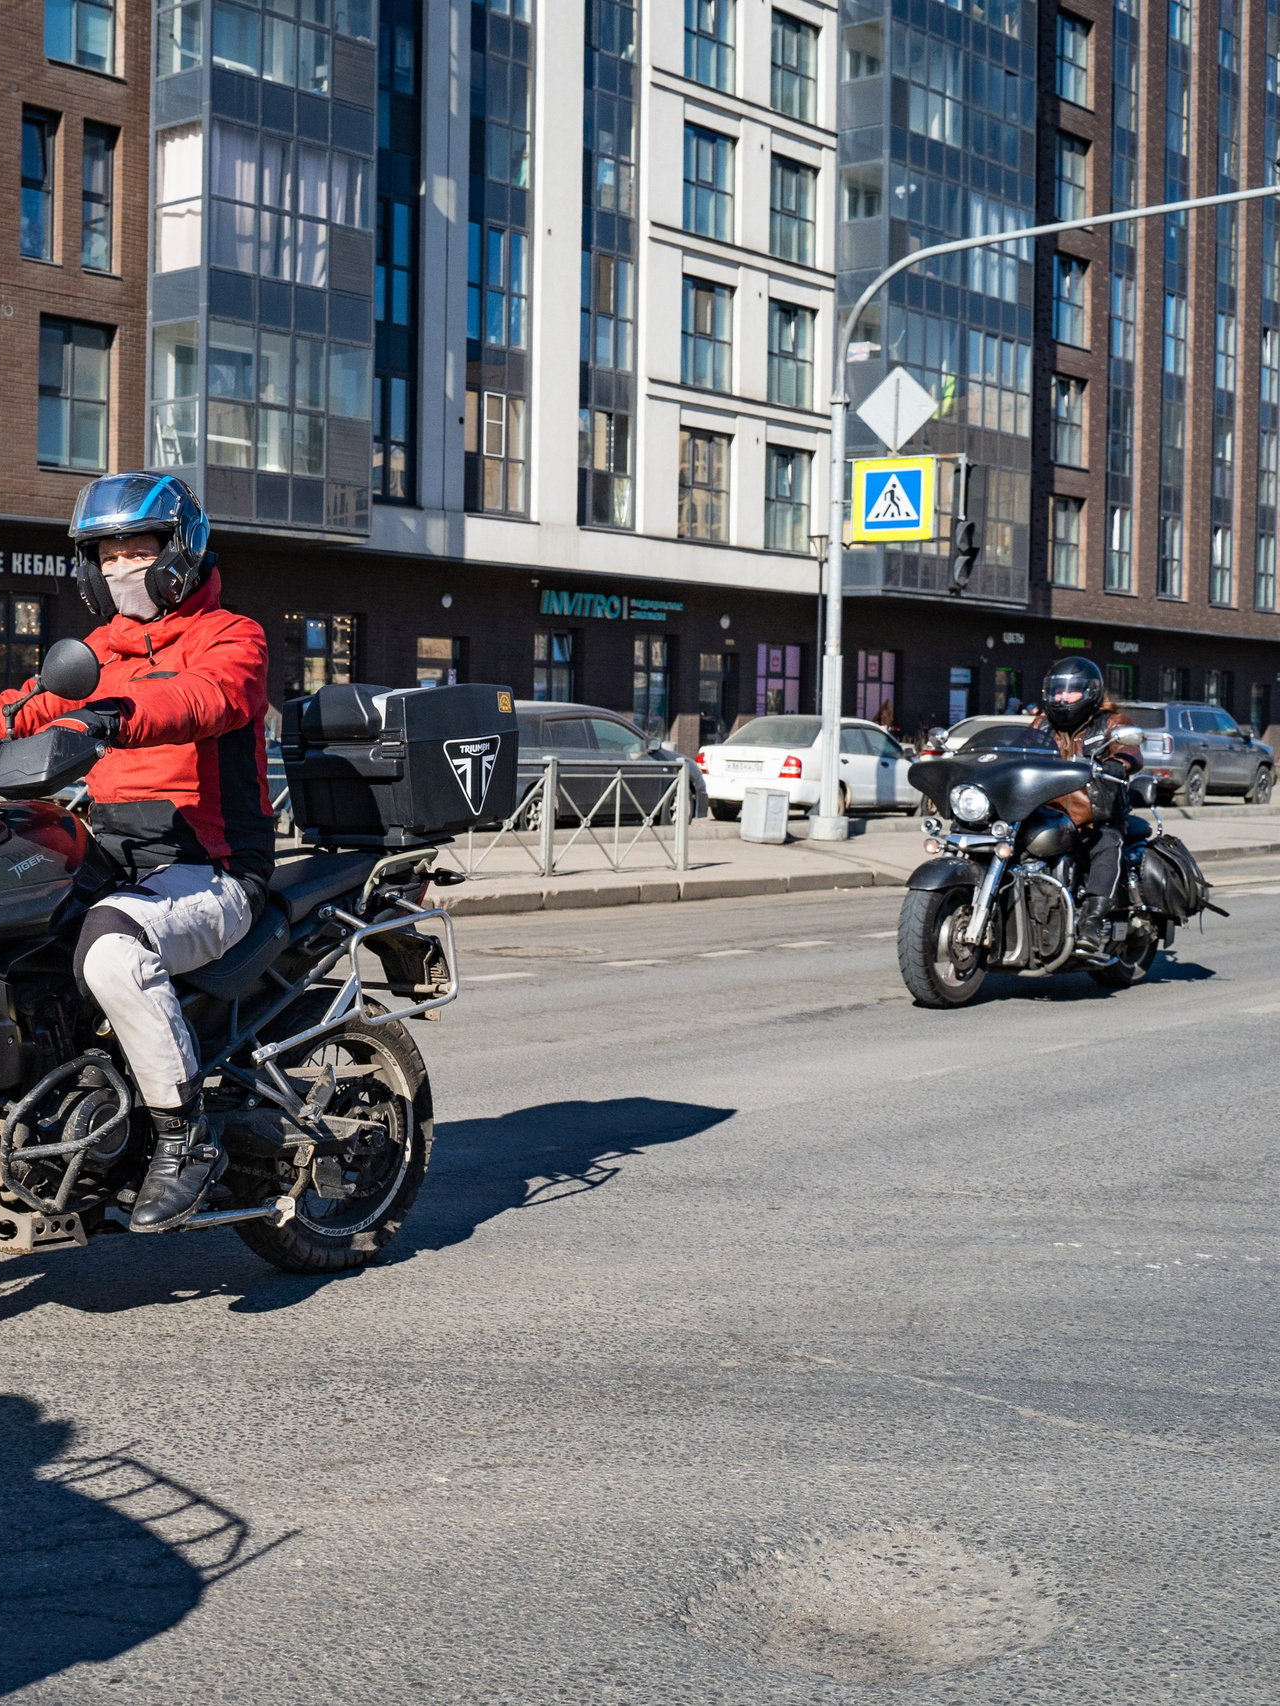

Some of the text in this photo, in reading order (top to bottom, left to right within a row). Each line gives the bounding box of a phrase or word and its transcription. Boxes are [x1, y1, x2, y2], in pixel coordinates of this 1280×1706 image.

[11, 552, 67, 577] КЕБАБ
[540, 588, 621, 620] INVITRO
[460, 742, 490, 755] TRIUMPH
[7, 853, 54, 879] TIGER
[323, 1220, 362, 1236] GRAPHIC
[362, 1212, 377, 1228] KIT
